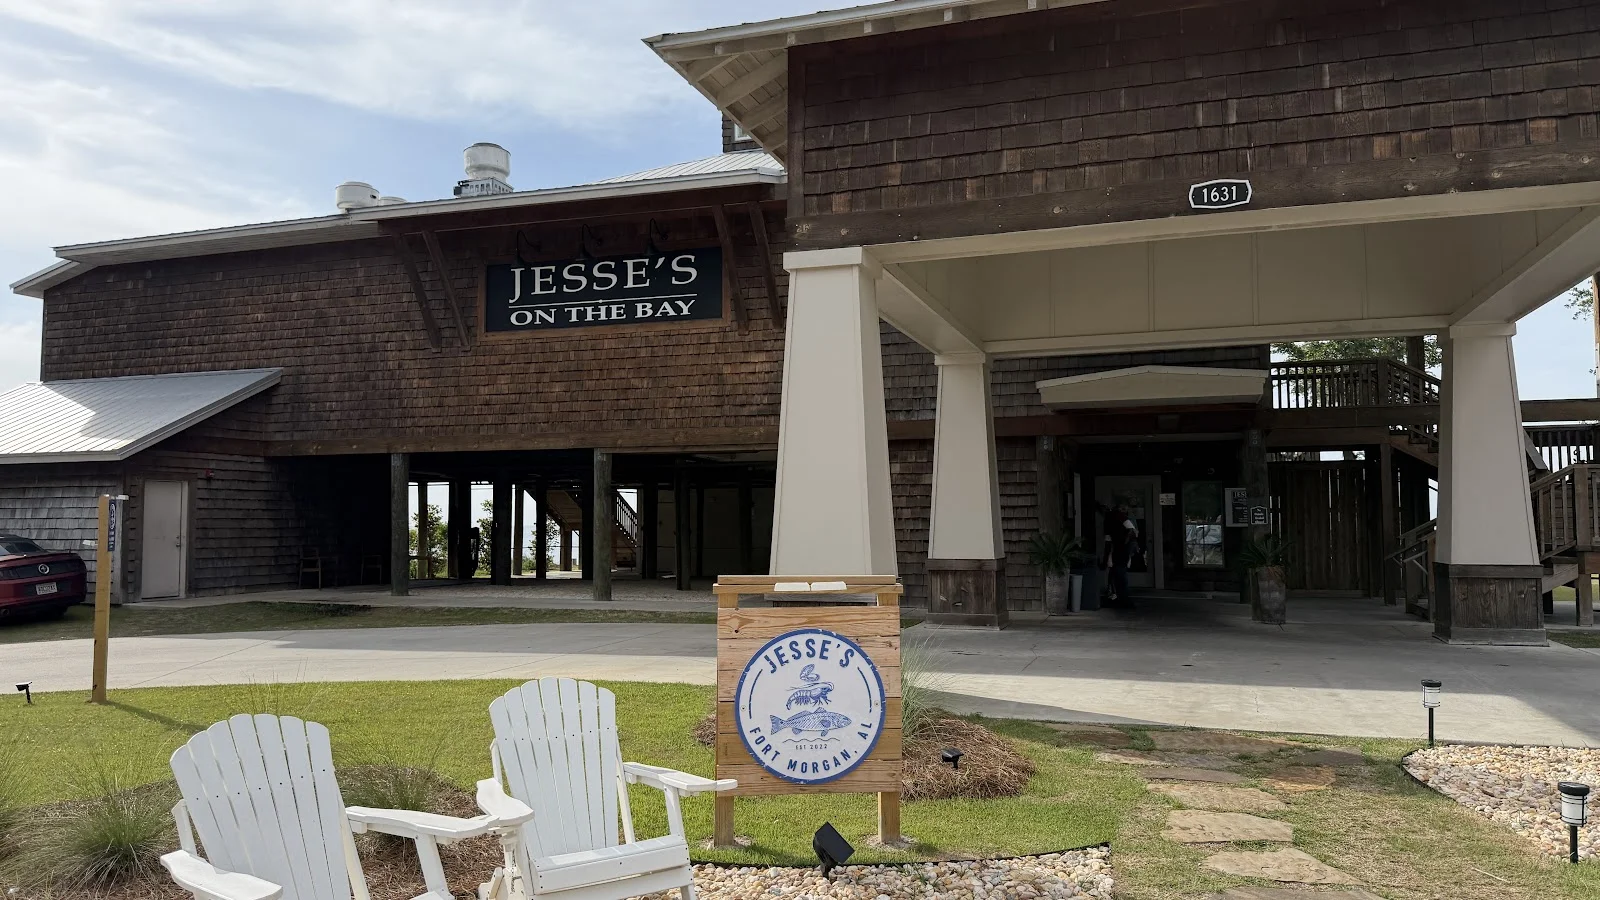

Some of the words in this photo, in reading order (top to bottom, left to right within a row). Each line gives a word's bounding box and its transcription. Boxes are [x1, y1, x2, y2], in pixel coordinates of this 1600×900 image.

[1202, 185, 1237, 203] 1631
[508, 254, 698, 304] JESSE'S
[509, 308, 558, 326] ON
[564, 303, 627, 323] THE
[634, 299, 696, 319] BAY
[764, 638, 855, 674] JESSE'S
[749, 726, 781, 762] FORT
[787, 749, 859, 774] MORGAN,
[857, 722, 873, 740] AL
